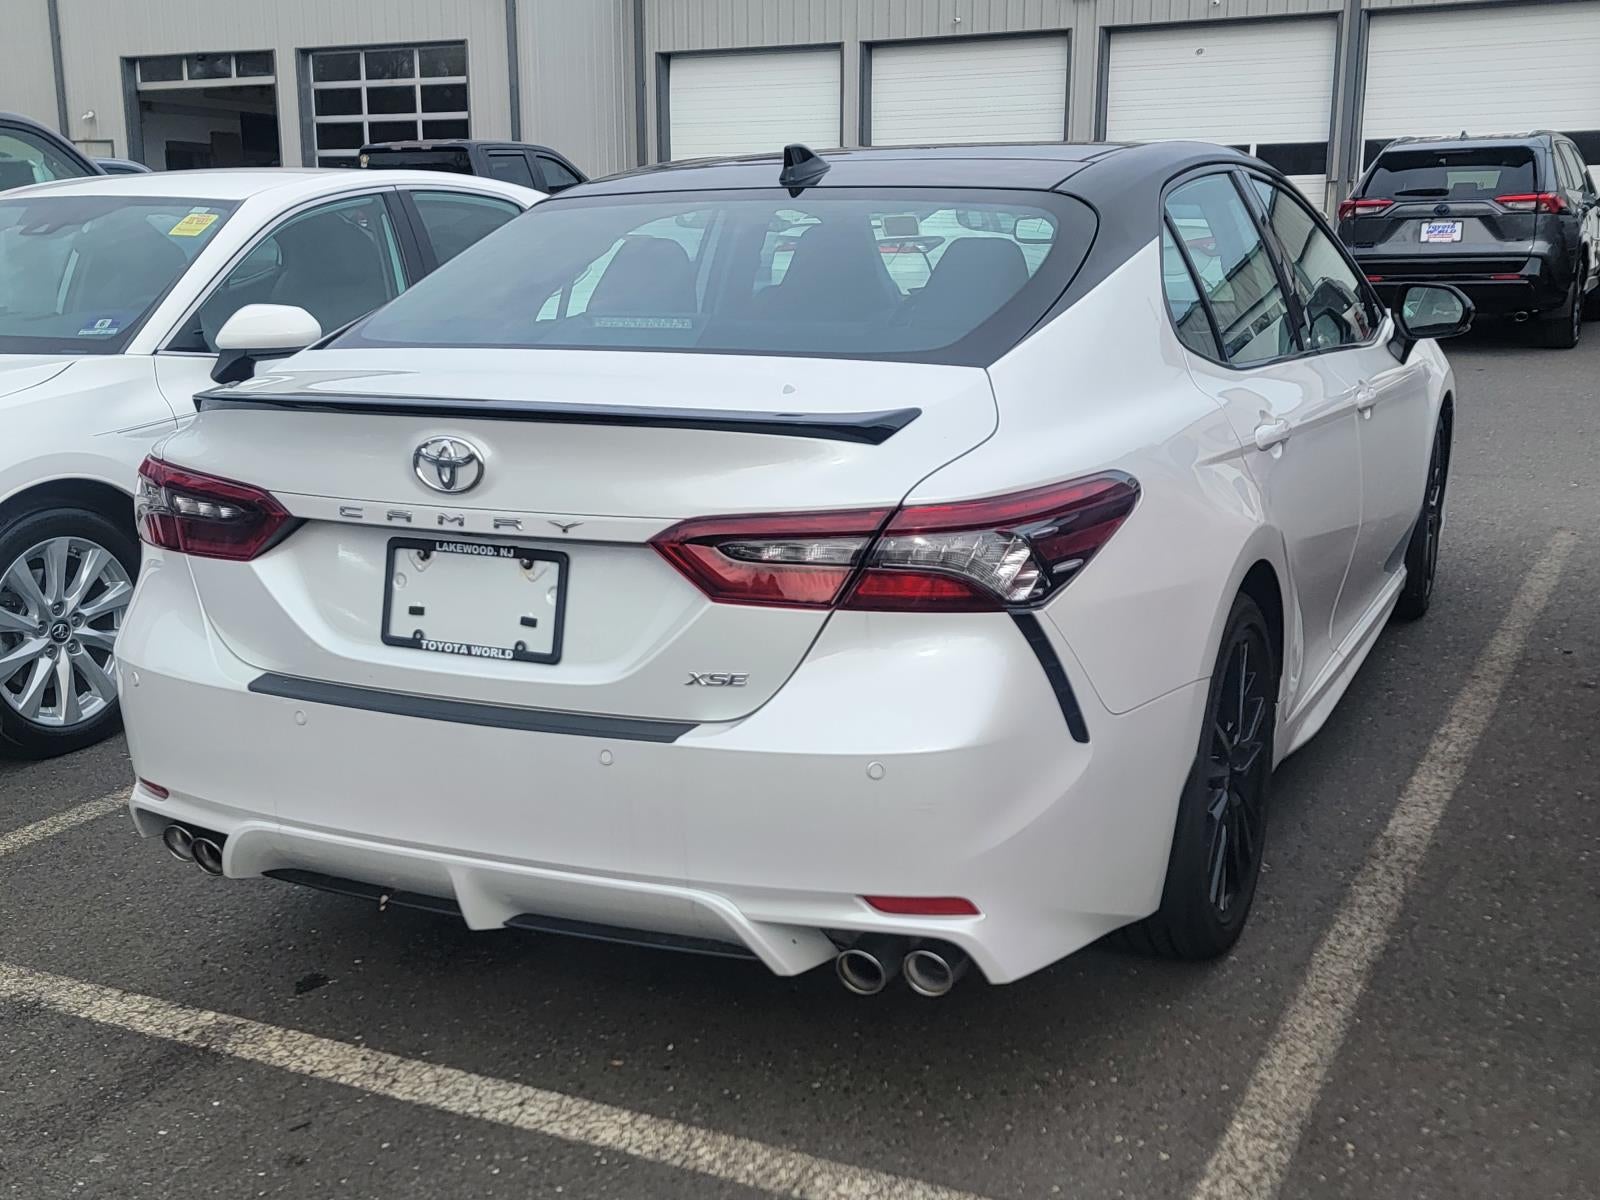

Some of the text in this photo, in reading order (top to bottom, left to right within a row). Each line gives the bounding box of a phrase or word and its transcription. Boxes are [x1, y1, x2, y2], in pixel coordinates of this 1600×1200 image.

[338, 505, 585, 534] CAMRY
[500, 547, 514, 558] NJ
[421, 640, 513, 659] TOYOTA WORLD
[685, 672, 748, 687] XSE
